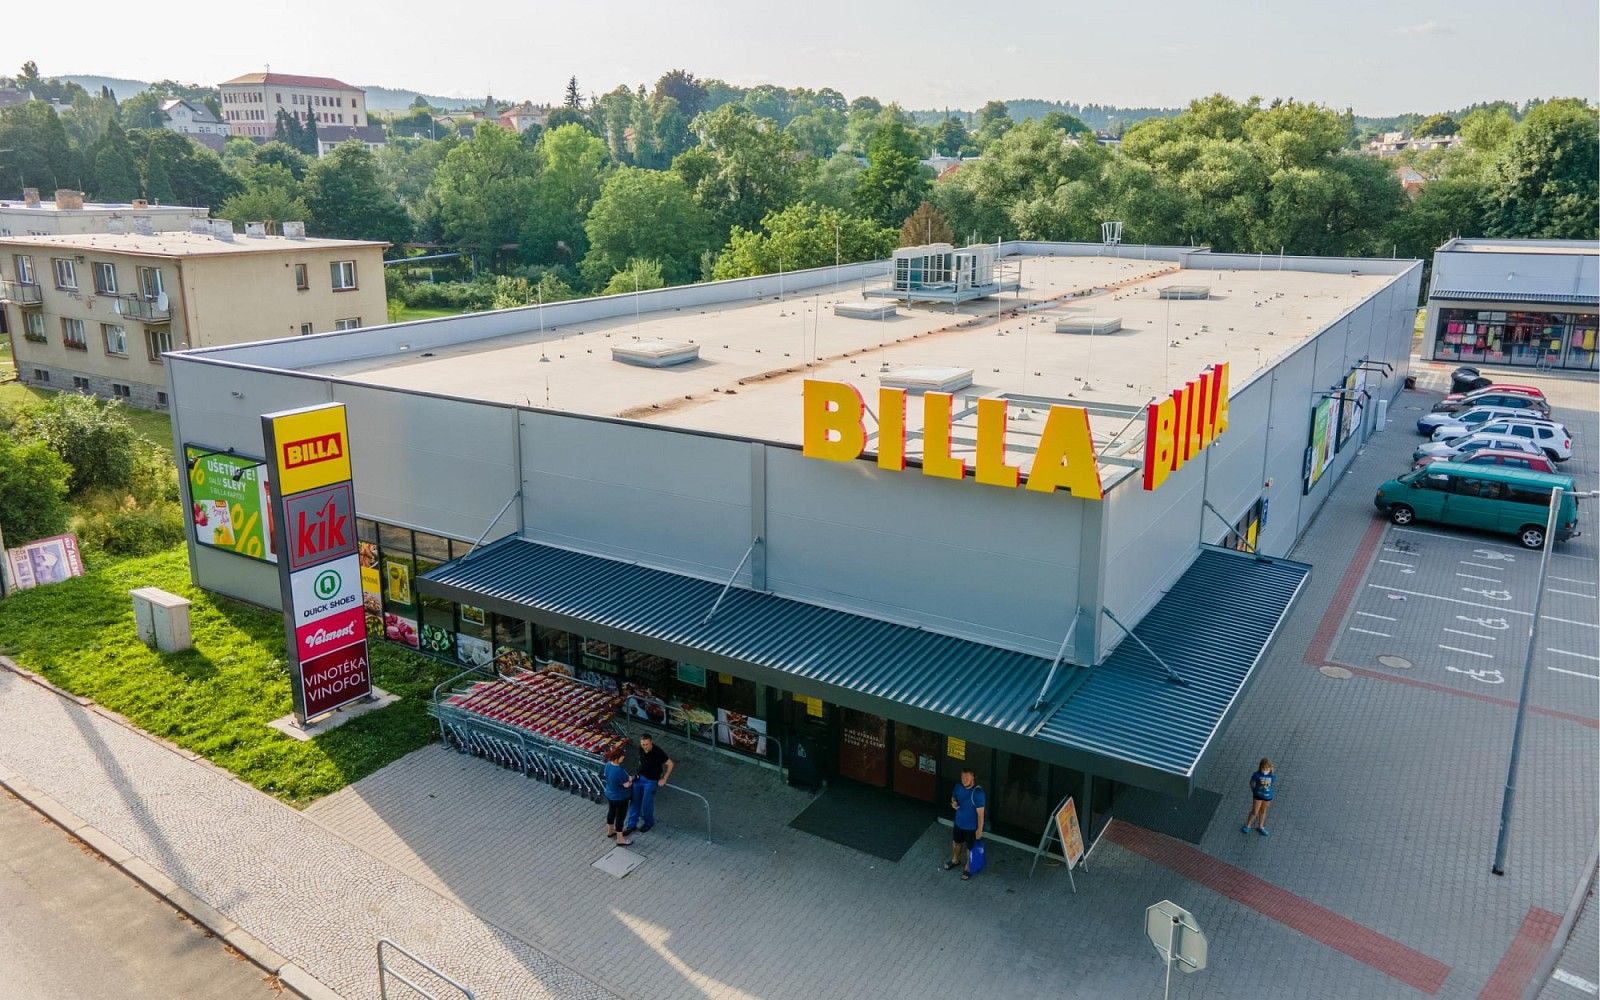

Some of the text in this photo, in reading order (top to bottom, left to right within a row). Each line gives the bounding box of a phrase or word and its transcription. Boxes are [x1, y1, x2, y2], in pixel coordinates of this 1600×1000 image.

[803, 379, 1104, 500] BILLA
[1143, 361, 1230, 492] BILLA
[287, 438, 340, 465] BILLA
[207, 458, 256, 481] UŠETŘTE!
[222, 478, 246, 492] SLEVY
[297, 495, 347, 560] kik
[303, 594, 356, 618] QUICK SHOES
[305, 621, 355, 648] Valmont
[305, 657, 367, 687] VINOTÉKA
[308, 671, 366, 702] VINOFOL
